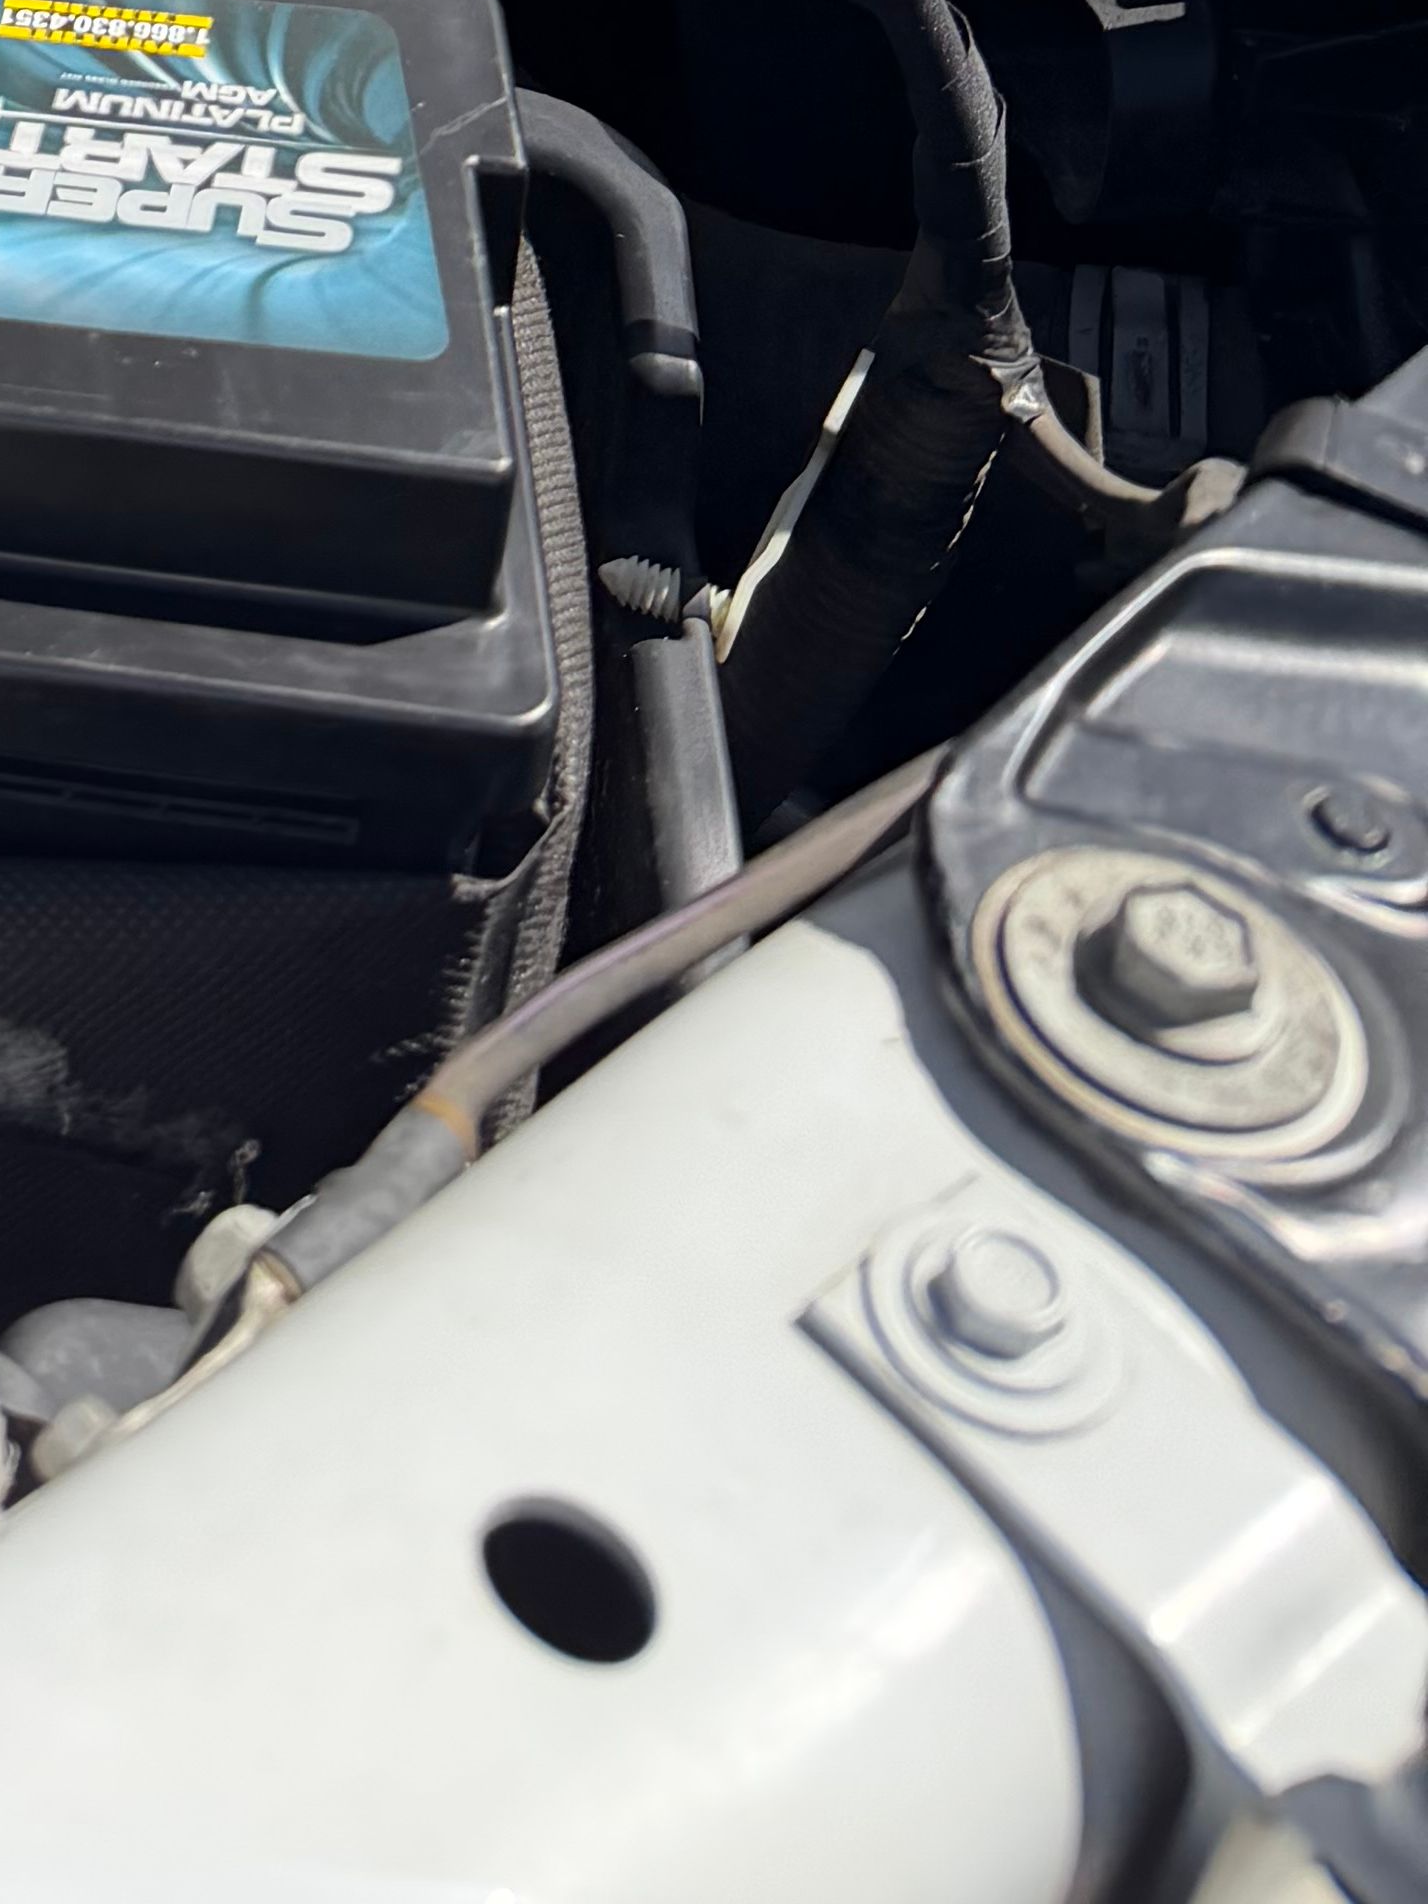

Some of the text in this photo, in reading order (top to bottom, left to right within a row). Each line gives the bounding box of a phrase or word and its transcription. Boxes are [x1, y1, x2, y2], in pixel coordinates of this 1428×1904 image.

[0, 7, 211, 45] 1.866.830.4351
[51, 87, 306, 136] PLATINUM
[180, 80, 279, 106] AGM
